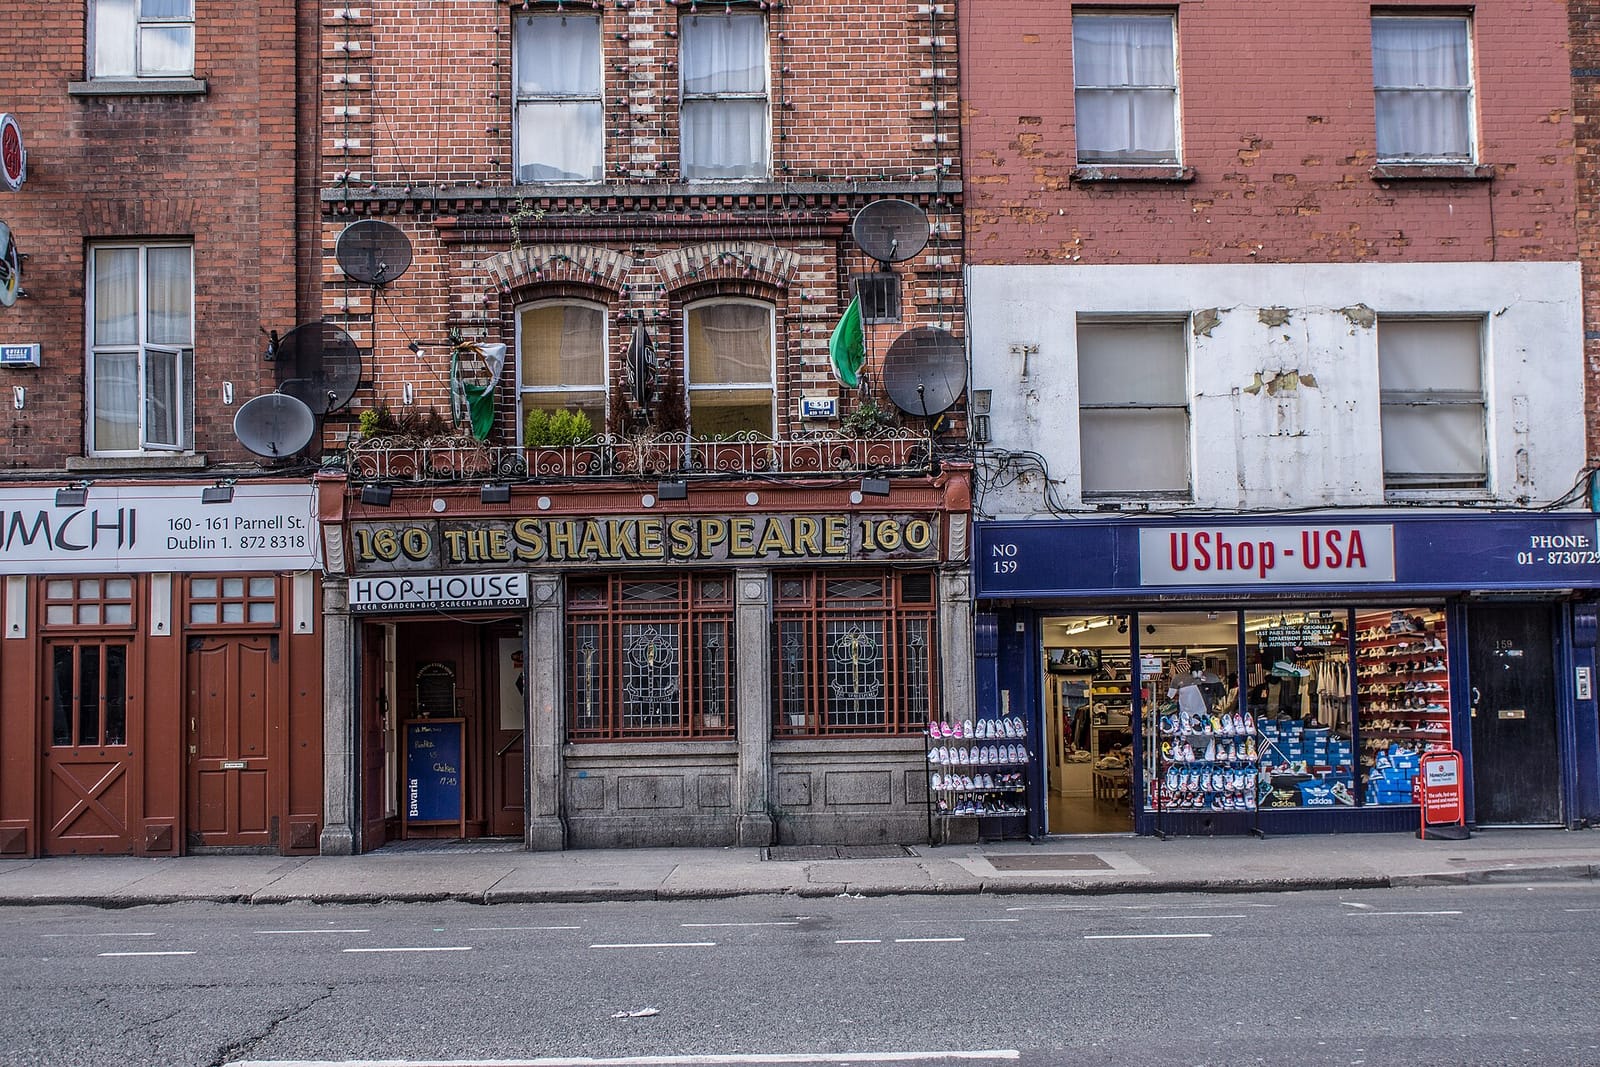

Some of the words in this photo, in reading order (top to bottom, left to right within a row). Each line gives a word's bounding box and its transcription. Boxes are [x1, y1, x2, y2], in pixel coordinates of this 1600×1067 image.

[167, 517, 192, 531] 160
[206, 517, 229, 530] 161
[234, 515, 283, 530] Parnell
[287, 515, 305, 529] St.
[167, 535, 215, 550] Dublin
[222, 536, 232, 549] 1.
[239, 536, 266, 549] 872
[270, 535, 305, 549] 8318
[356, 528, 432, 562] 160
[444, 528, 510, 562] THE
[513, 515, 849, 563] SHAKESPEARE
[861, 518, 932, 551] 160
[1531, 534, 1590, 549] PHONE:
[992, 544, 1018, 557] NO
[1517, 552, 1534, 565] 01
[993, 560, 1018, 574] 159
[356, 575, 519, 602] HOP-HOUSE
[381, 602, 416, 610] GARDEN
[440, 600, 472, 608] SCREEN
[497, 598, 521, 606] FOOD
[1496, 639, 1513, 649] 159
[409, 779, 419, 817] Bavaria
[1308, 797, 1333, 805] adidas
